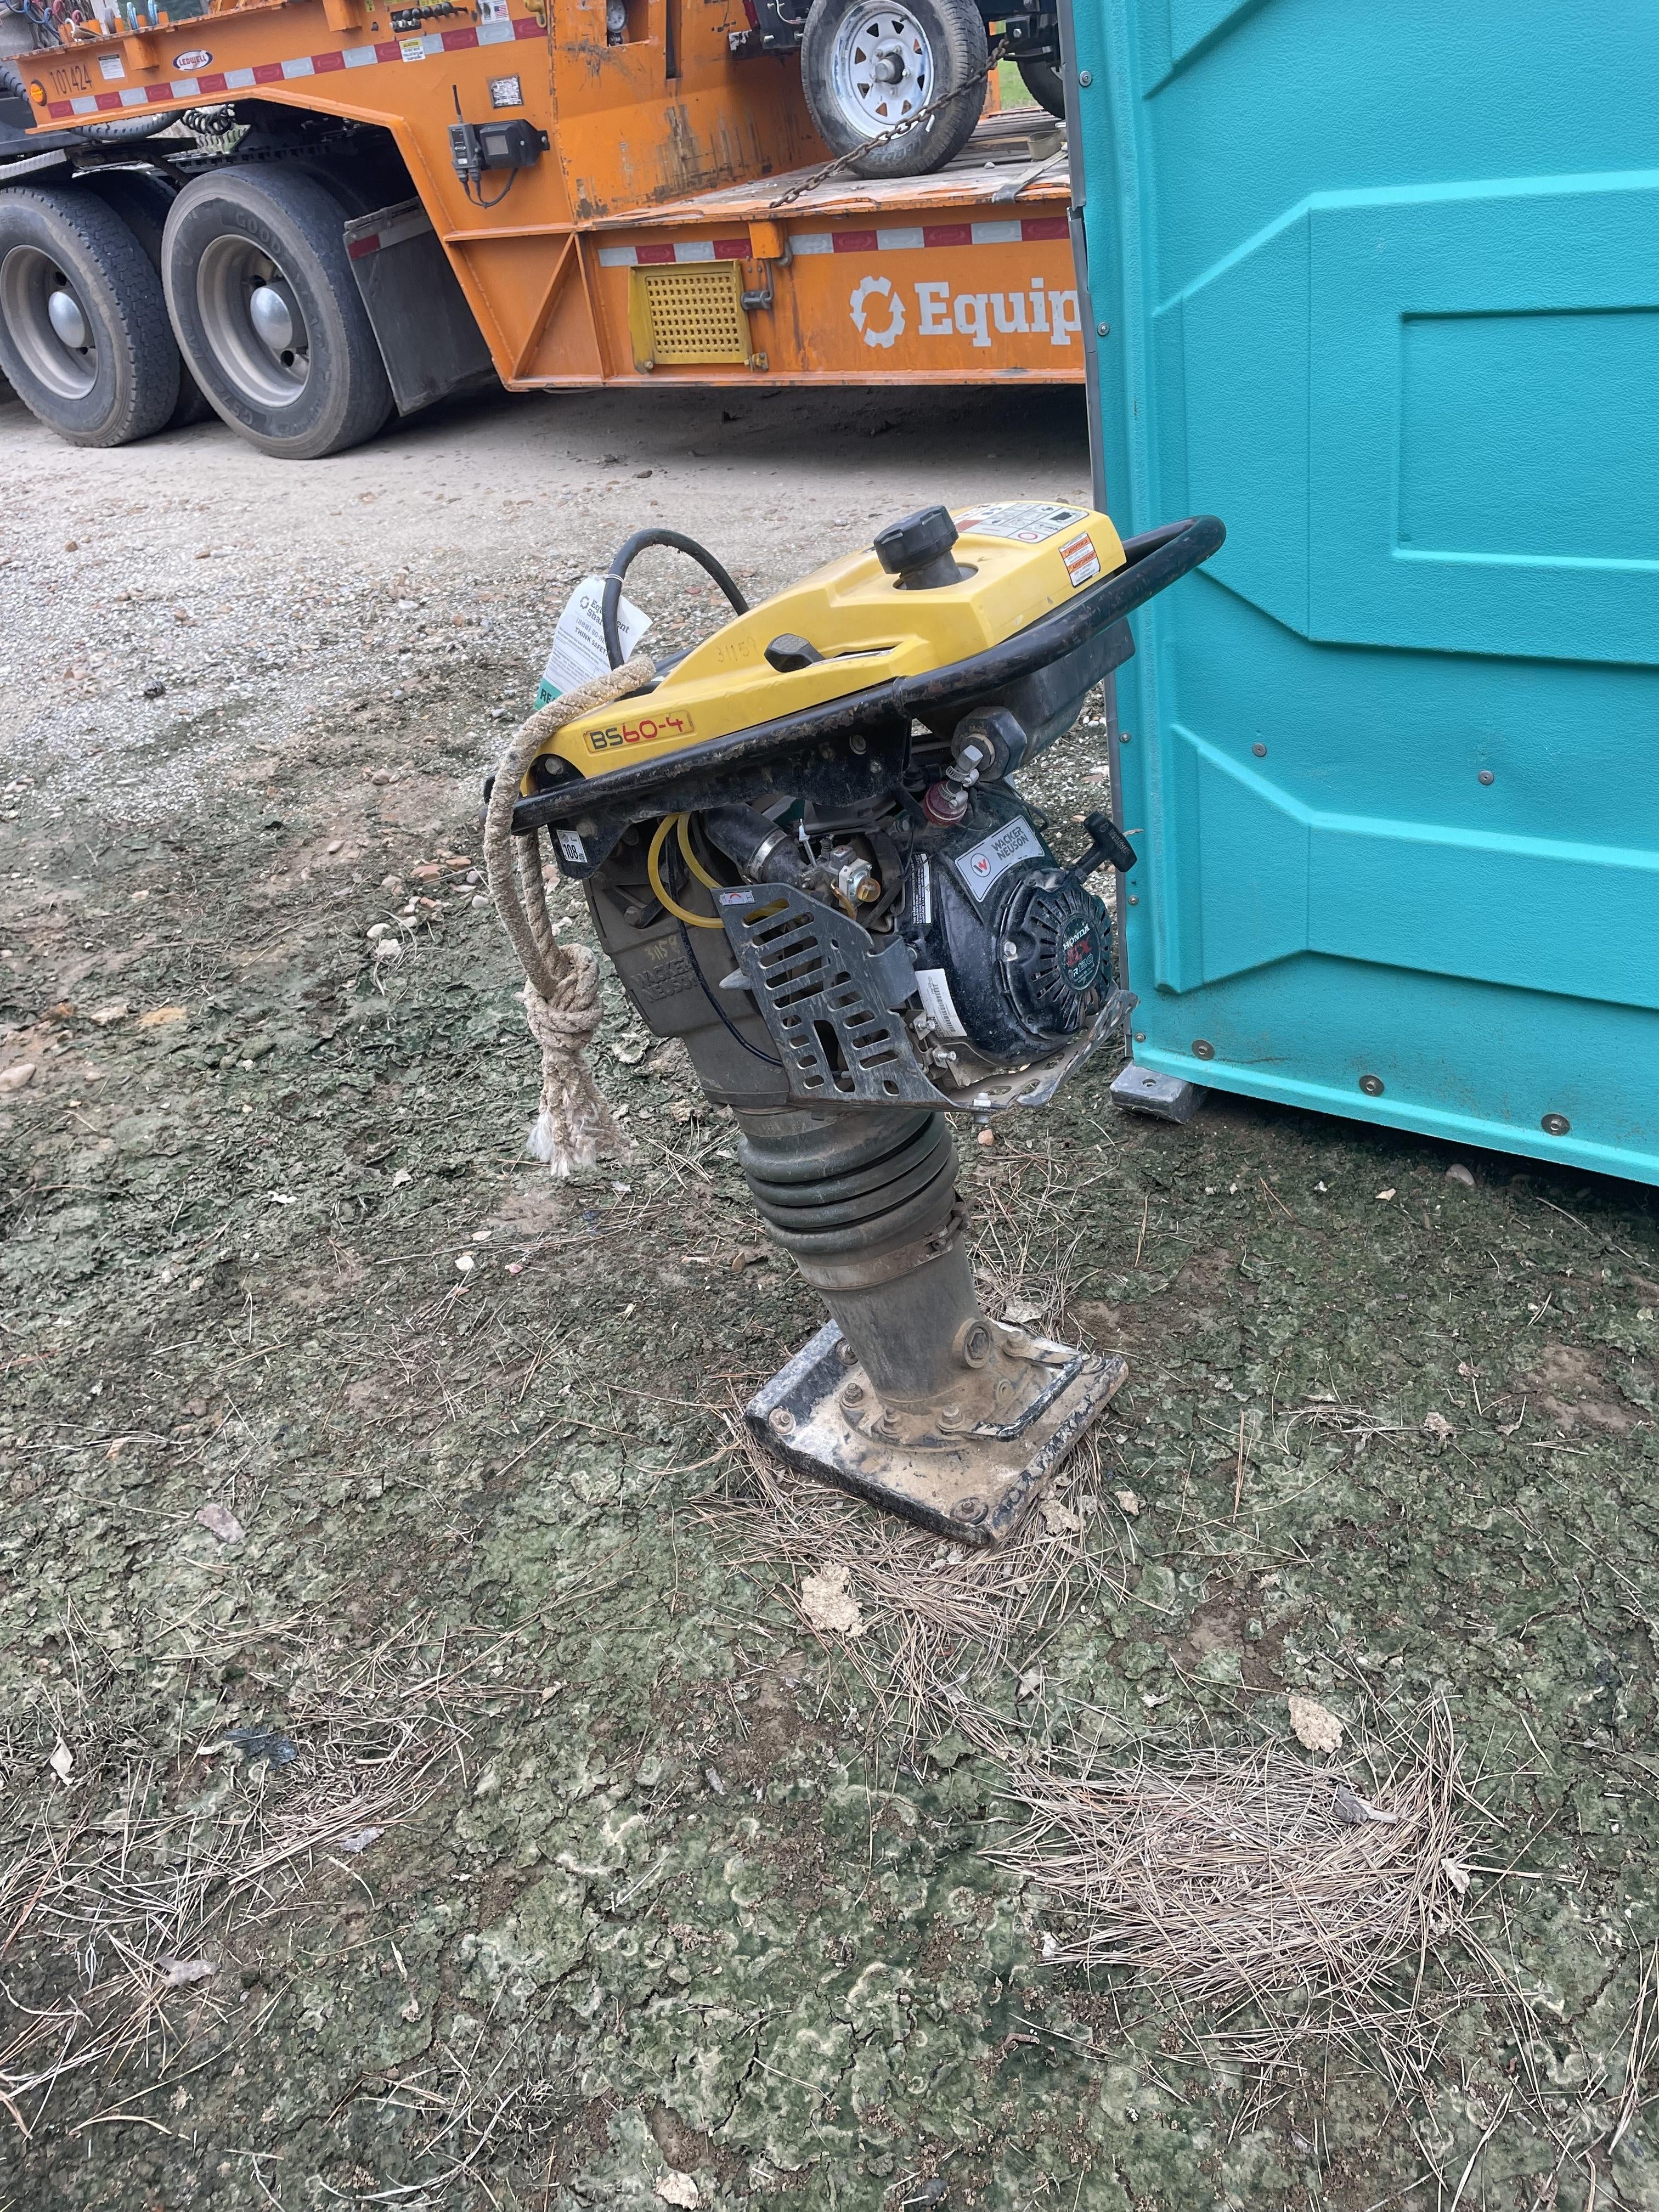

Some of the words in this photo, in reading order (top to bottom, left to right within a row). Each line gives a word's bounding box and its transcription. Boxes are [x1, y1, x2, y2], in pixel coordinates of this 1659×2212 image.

[178, 55, 207, 66] LEDWELL
[49, 64, 92, 95] 101424
[914, 278, 1082, 347] Equip
[575, 626, 592, 642] THINK
[590, 716, 684, 749] BS60-4
[563, 844, 579, 860] 108
[991, 826, 1024, 852] WACKER
[996, 833, 1029, 861] NEUSON
[1063, 923, 1090, 951] HONDA
